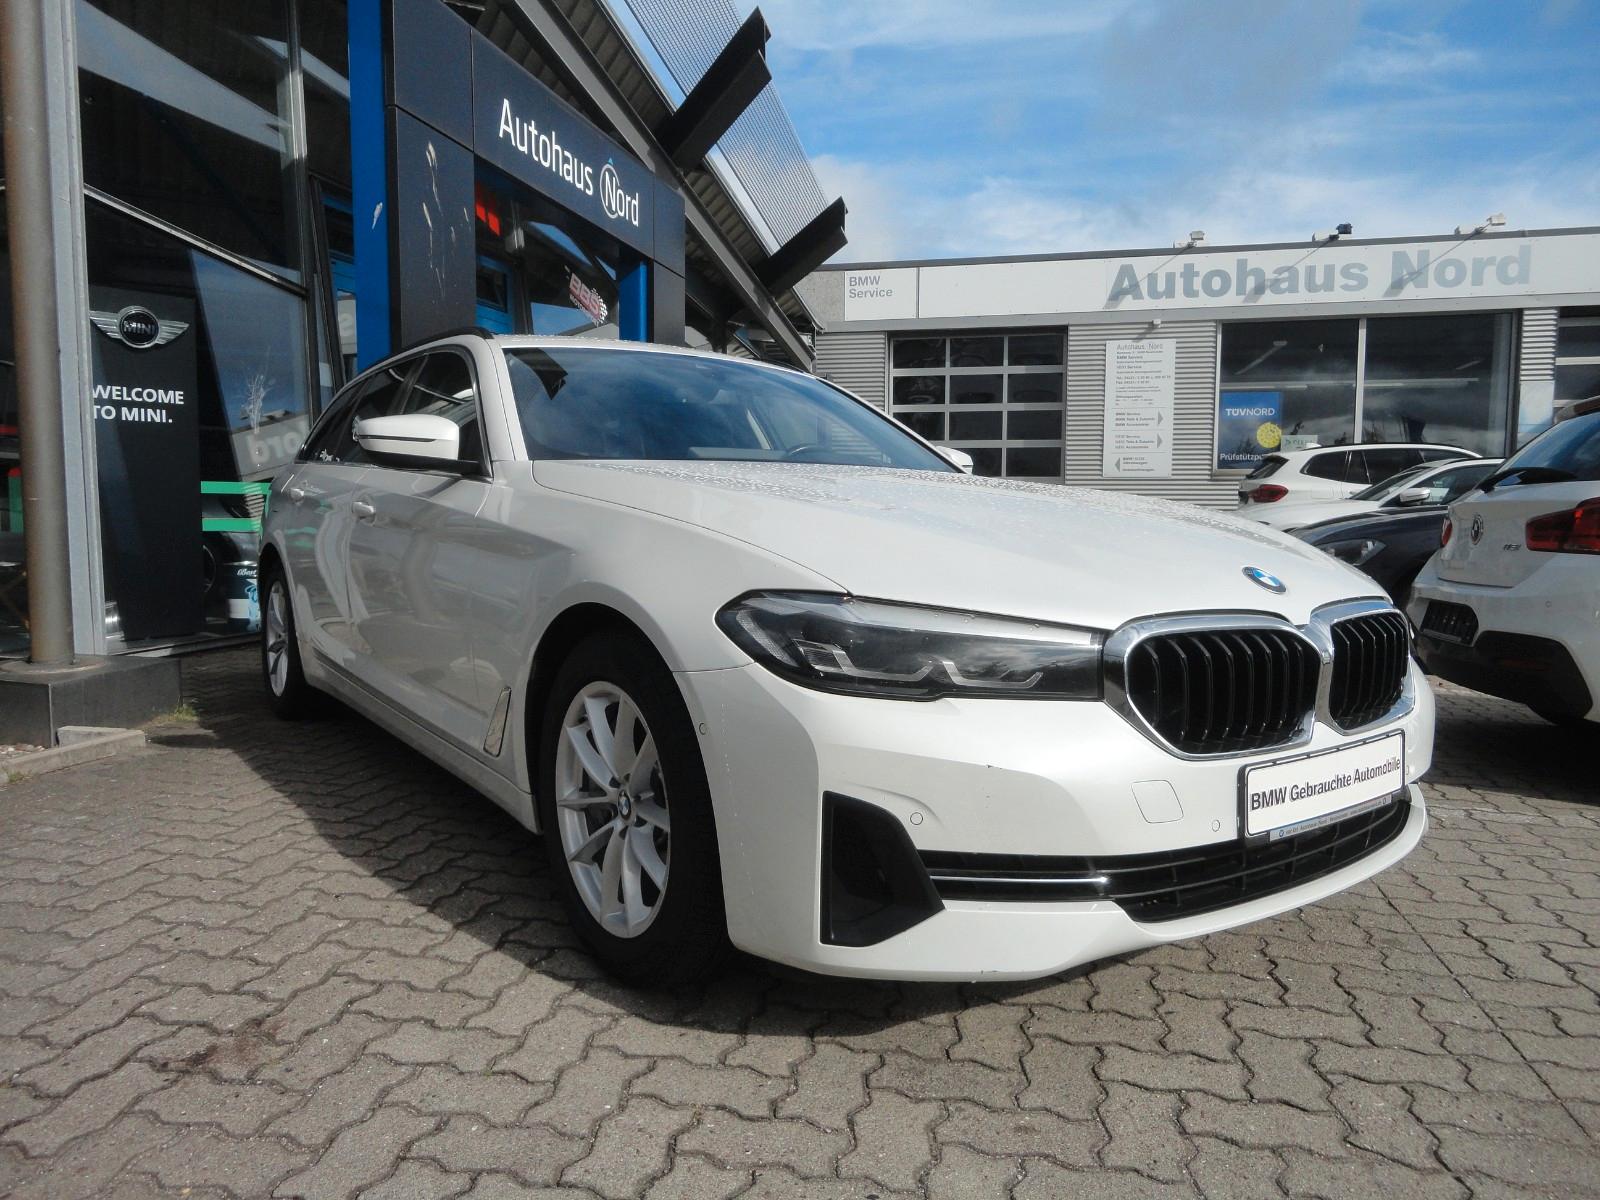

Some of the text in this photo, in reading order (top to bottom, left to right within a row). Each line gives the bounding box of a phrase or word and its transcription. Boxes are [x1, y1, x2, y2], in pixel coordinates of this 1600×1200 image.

[499, 98, 639, 227] Autohaus Nord
[849, 275, 881, 287] BMW
[1109, 245, 1532, 301] Autohaus Nord
[848, 287, 893, 299] Service
[92, 384, 185, 405] WELCOME
[93, 405, 173, 423] TO MINI.
[1250, 757, 1401, 811] BMW Gebrauchte Automobile
